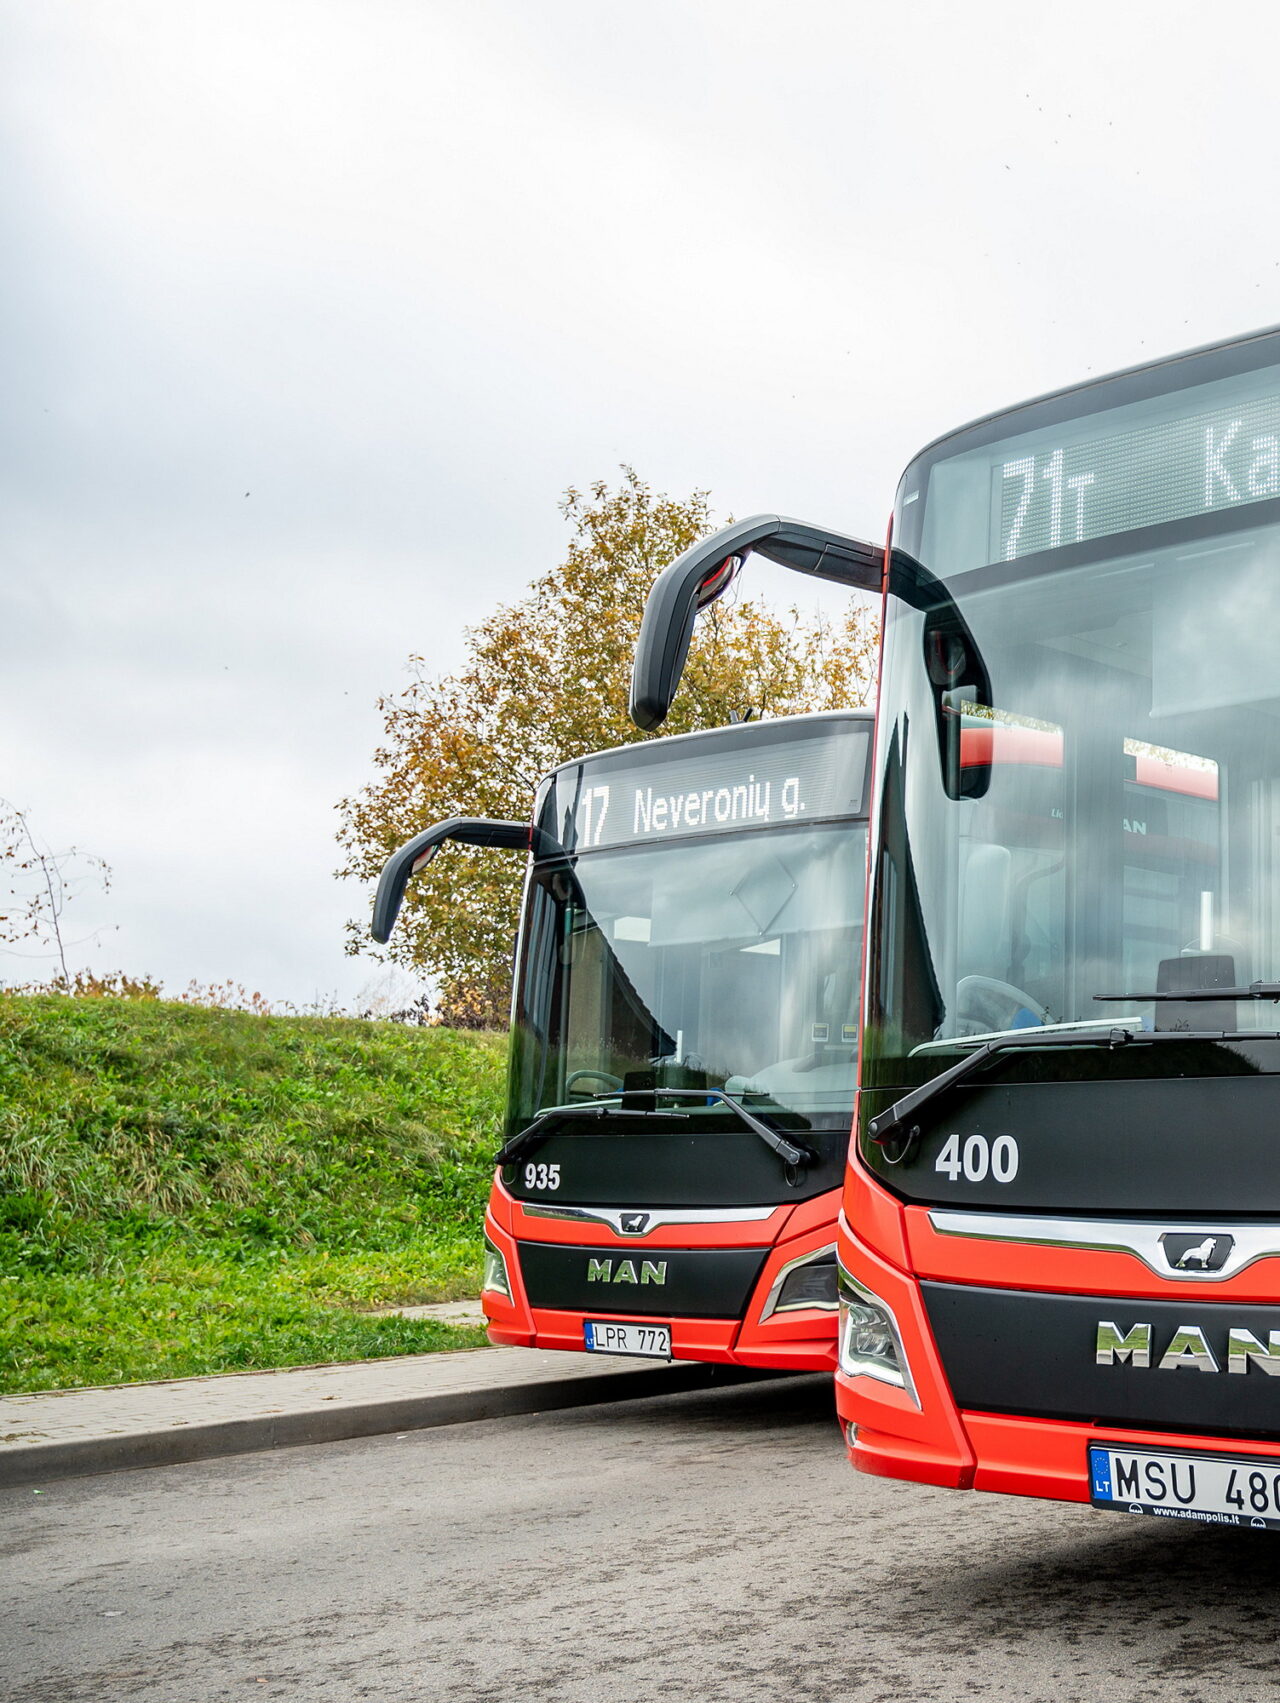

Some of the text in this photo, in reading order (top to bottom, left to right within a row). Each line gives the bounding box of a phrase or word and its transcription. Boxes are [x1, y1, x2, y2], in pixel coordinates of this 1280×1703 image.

[582, 775, 806, 847] 17 Neveronių g.
[1123, 818, 1146, 835] AN
[935, 1134, 1019, 1183] 400
[525, 1163, 561, 1191] 935
[587, 1258, 668, 1285] MAN
[595, 1326, 628, 1349] LPR
[638, 1329, 667, 1352] 772
[1096, 1480, 1110, 1493] LT
[1115, 1457, 1196, 1505] MSU
[1153, 1507, 1240, 1525] www.adampolis.lt
